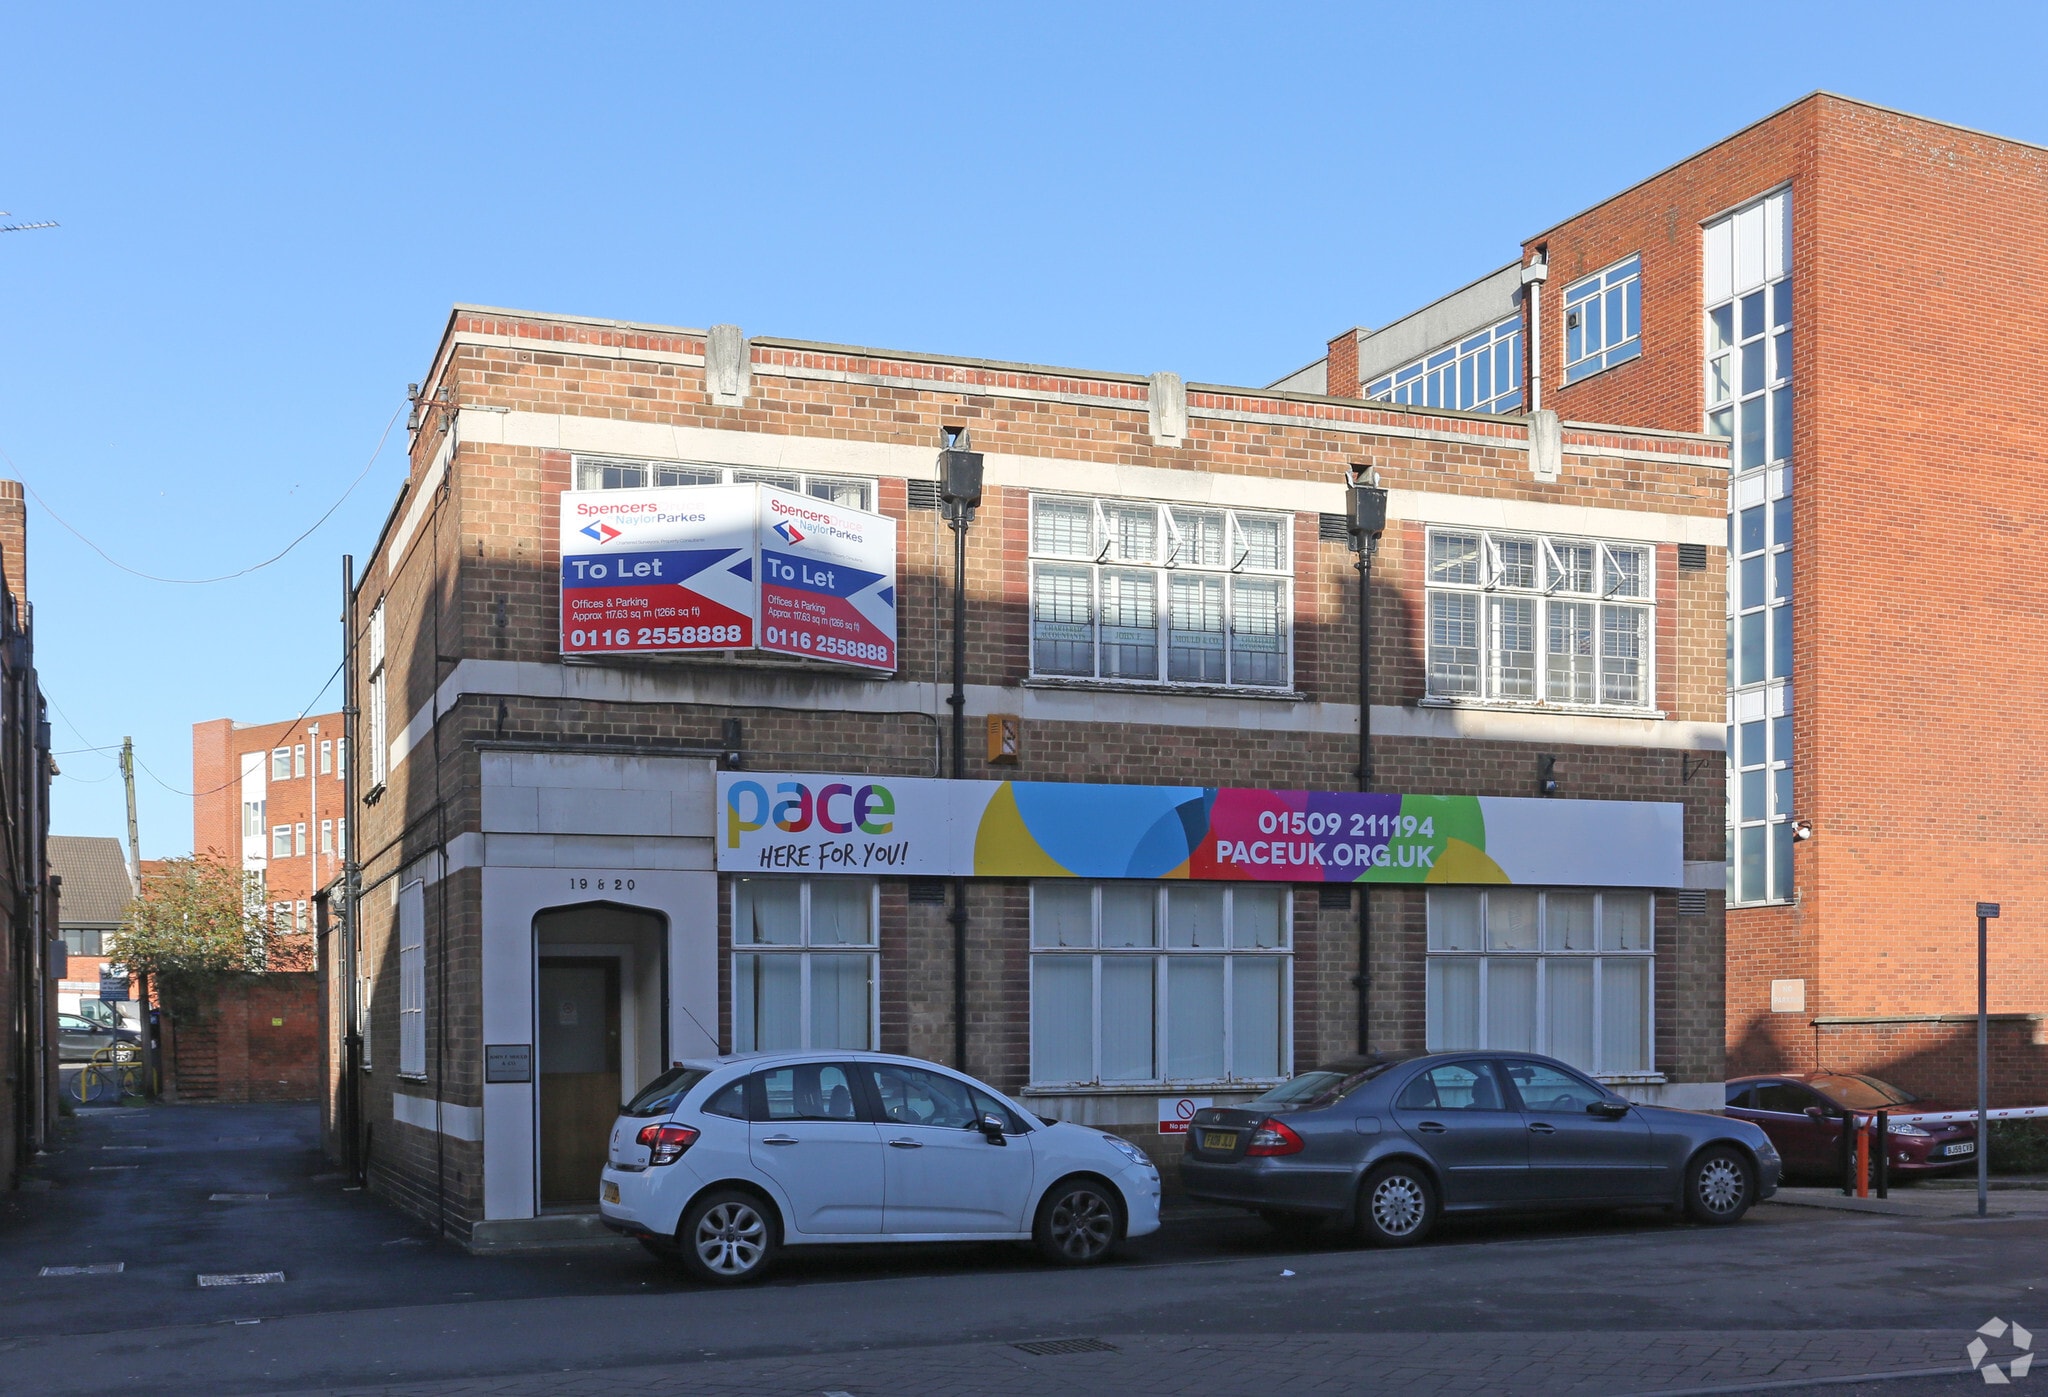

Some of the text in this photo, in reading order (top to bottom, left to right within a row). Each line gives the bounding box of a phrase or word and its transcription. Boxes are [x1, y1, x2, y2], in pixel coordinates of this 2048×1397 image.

[572, 558, 663, 580] To Let
[767, 557, 835, 590] To Let
[571, 597, 648, 609] Offices & Parking
[767, 594, 826, 615] Offices & Parking
[572, 611, 602, 622] Approx
[605, 610, 628, 619] 117.63
[630, 610, 641, 620] sq
[654, 608, 675, 619] (1266
[678, 609, 689, 618] sq
[691, 606, 701, 617] ft)
[768, 606, 791, 619] Approx
[793, 611, 811, 622] 117.63
[811, 616, 821, 626] sq
[829, 617, 844, 628] (1266
[845, 621, 853, 631] sq
[571, 625, 742, 646] 0116 2558888
[766, 626, 888, 662] 0116 2558888
[1115, 631, 1135, 640] JOHN
[1175, 635, 1201, 643] MOULD
[1241, 635, 1275, 644] CHARTERE
[728, 780, 896, 848] pace
[1258, 811, 1435, 838] 01509 211194
[760, 841, 909, 870] HERE FOR YOU!
[1216, 840, 1435, 868] PACEUK.ORG.UK
[598, 879, 605, 890] &
[614, 879, 635, 890] 20
